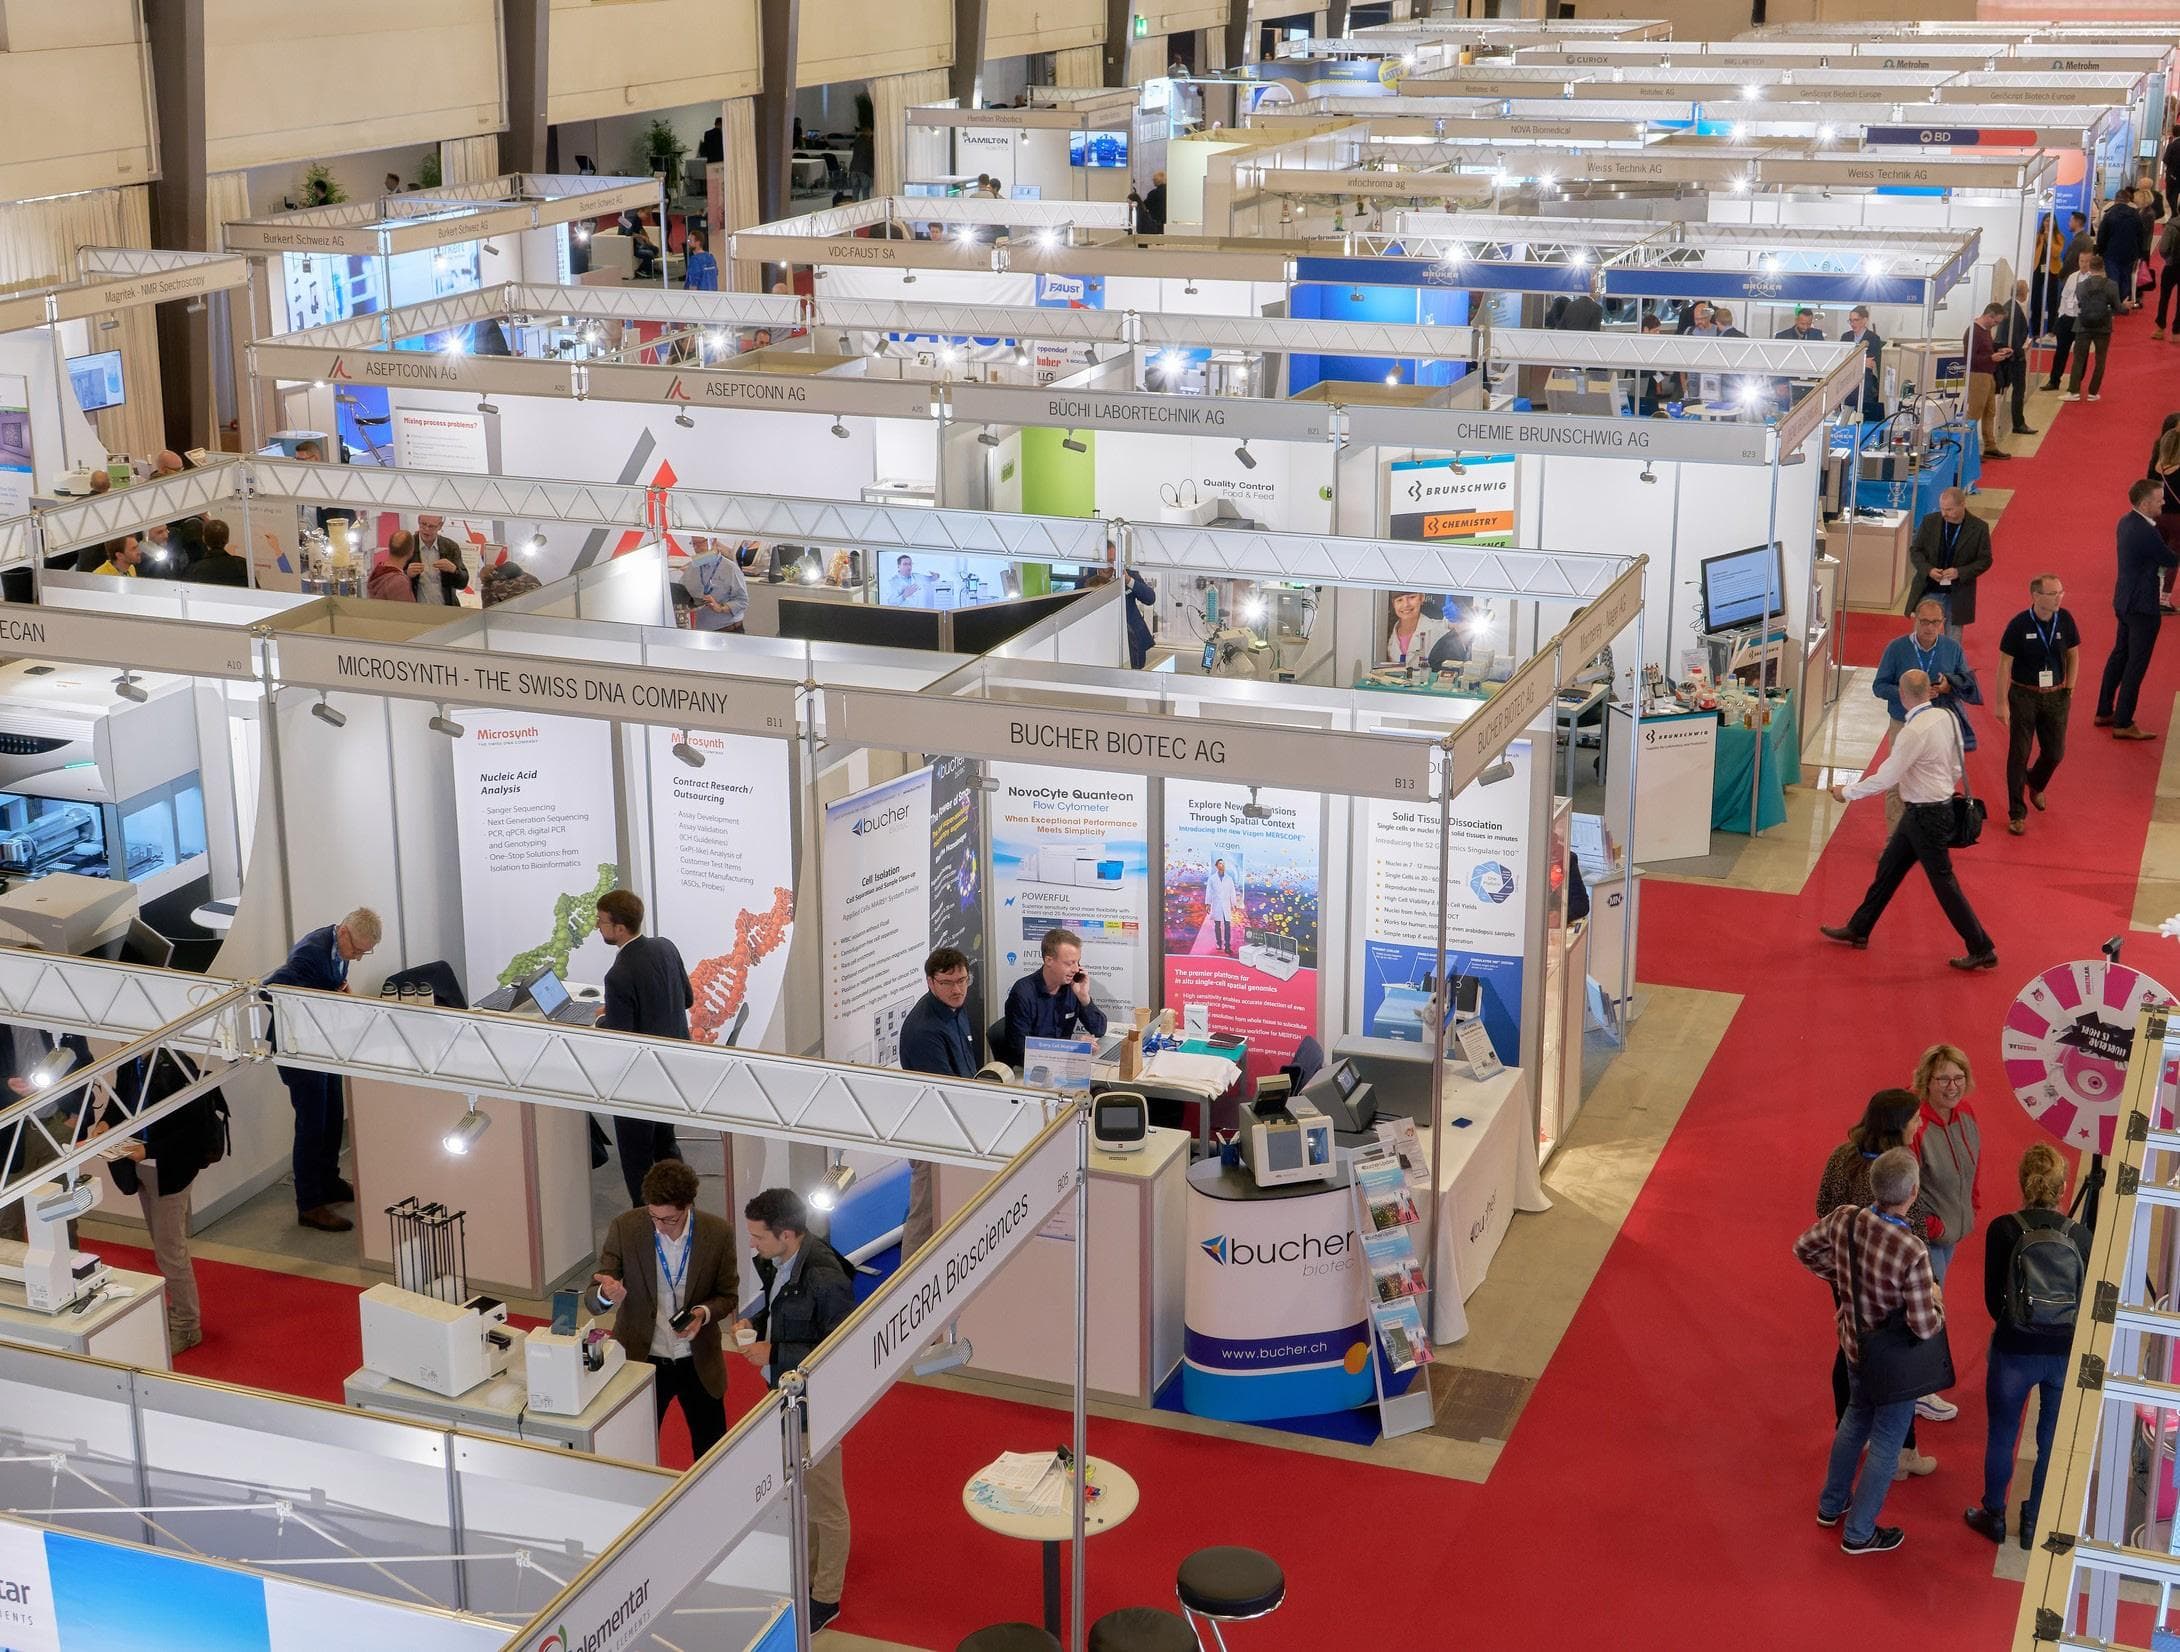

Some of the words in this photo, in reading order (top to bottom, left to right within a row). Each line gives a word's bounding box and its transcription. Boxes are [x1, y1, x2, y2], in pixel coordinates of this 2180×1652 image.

[1576, 56, 1608, 64] CURIOX
[1896, 59, 1930, 69] Metrohm
[2065, 60, 2100, 71] Metrohm
[1800, 89, 1832, 99] GenScript
[1859, 90, 1882, 99] Europe
[1990, 92, 2024, 101] GenScript
[2025, 92, 2051, 101] Biotech
[2052, 93, 2076, 101] Europe
[1511, 125, 1531, 134] NOVA
[1532, 125, 1571, 135] Biomedical
[1935, 132, 1951, 141] BD
[1587, 163, 1612, 173] Weiss
[1615, 163, 1647, 174] Technik
[1649, 164, 1662, 174] AG
[1848, 169, 1875, 179] Weiss
[1878, 169, 1911, 179] Technik
[1914, 170, 1928, 180] AG
[1347, 178, 1393, 188] infochroma
[1395, 180, 1406, 190] ag
[480, 220, 489, 230] AG
[295, 234, 330, 246] Schweiz
[332, 235, 345, 247] AG
[828, 246, 880, 259] VDC-FAUST
[882, 247, 896, 259] SA
[1422, 271, 1459, 279] BRUKER
[105, 286, 137, 304] Magritek
[141, 281, 158, 297] NMR
[158, 275, 205, 296] Spectroscopy
[1049, 282, 1081, 294] FAUST
[1037, 346, 1068, 355] eppendorf
[366, 361, 438, 380] ASEPTCONN
[440, 368, 457, 381] AG
[706, 382, 784, 400] ASEPTCONN
[788, 387, 806, 401] AG
[1049, 398, 1091, 418] BÜCHI
[1095, 403, 1201, 424] LABORTECHNIK
[1204, 409, 1225, 426] AG
[403, 417, 423, 427] Mixing
[423, 418, 446, 429] process
[447, 419, 478, 430] problems?
[1456, 423, 1514, 442] CHEMIE
[1519, 425, 1624, 447] BRUNSCHWIG
[1627, 430, 1649, 448] AG
[1203, 478, 1236, 491] Quality
[1238, 480, 1275, 492] Control
[1426, 481, 1507, 496] BRUNSCHWIG
[1223, 488, 1243, 499] Food
[1253, 492, 1275, 501] Feed
[1442, 517, 1498, 529] CHEMISTRY
[0, 620, 46, 643] ECAN
[226, 660, 242, 670] A10
[337, 655, 458, 687] MICROSYNTH
[474, 668, 511, 693] THE
[518, 672, 578, 700] SWISS
[585, 680, 626, 704] DNA
[632, 685, 728, 714] COMPANY
[767, 717, 783, 728] B11
[1477, 710, 1504, 754] BUCHER
[1503, 688, 1526, 729] BIOTEC
[1526, 682, 1535, 706] AG
[477, 726, 539, 740] Microsynth
[1658, 730, 1709, 740] BRUNSCHWIG
[671, 732, 725, 749] Mirosynth
[1010, 722, 1099, 751] BUCHER
[1107, 731, 1186, 760] BIOTEC
[1194, 739, 1225, 764] AG
[480, 771, 515, 782] Nucleic
[516, 770, 538, 780] Acid
[480, 785, 521, 796] Analysis
[673, 776, 709, 789] Contract
[710, 781, 749, 794] Research
[1394, 778, 1415, 790] B13
[673, 789, 725, 805] Outsourcing
[1008, 786, 1069, 800] NovoCyte
[1072, 789, 1134, 801] Quanteon
[486, 806, 512, 815] Sanger
[513, 804, 556, 813] Sequencing
[1032, 800, 1055, 810] Flow
[1057, 801, 1110, 813] Cytometer
[1188, 799, 1222, 810] Explore
[487, 817, 504, 826] Next
[505, 815, 546, 824] Generation
[547, 812, 589, 823] Sequencing
[678, 810, 696, 821] Assay
[697, 813, 740, 826] Development
[863, 804, 910, 834] bucher
[1004, 815, 1029, 823] When
[1031, 816, 1081, 826] Exceptional
[1083, 818, 1138, 828] Performance
[1189, 812, 1228, 823] Through
[1230, 814, 1259, 826] Spatial
[1261, 817, 1296, 830] Context
[1392, 811, 1415, 823] Solid
[1417, 813, 1441, 825] Tissu
[1449, 817, 1503, 831] Dissociation
[527, 827, 550, 835] digital
[551, 825, 566, 833] PCR
[678, 822, 696, 832] Assay
[1037, 826, 1062, 834] Meets
[1064, 827, 1106, 837] Simplicity
[1178, 825, 1216, 835] Introducing
[1216, 826, 1228, 834] the
[1242, 829, 1264, 838] Vizgen
[1376, 821, 1395, 831] Single
[1450, 830, 1465, 839] solid
[1465, 832, 1486, 841] tissues
[1494, 834, 1519, 843] minutes
[489, 840, 503, 850] and
[504, 839, 547, 848] Genotyping
[1375, 836, 1412, 848] Introducing
[1412, 840, 1424, 849] the
[561, 848, 579, 856] from
[490, 863, 520, 873] Isolation
[522, 862, 530, 870] to
[861, 877, 873, 887] Cell
[874, 866, 901, 882] Isolation
[1021, 892, 1071, 903] POWERFUL
[1188, 970, 1213, 979] premier
[1240, 973, 1250, 982] for
[1247, 985, 1278, 994] genomics
[1056, 1171, 1069, 1193] B05
[1231, 1230, 1354, 1265] bucher
[1302, 1258, 1354, 1278] biotec
[872, 1273, 942, 1370] INTEGRA
[946, 1193, 1029, 1295] Biosciences
[1222, 1342, 1327, 1359] www.bucher.ch
[754, 1473, 772, 1503] B03
